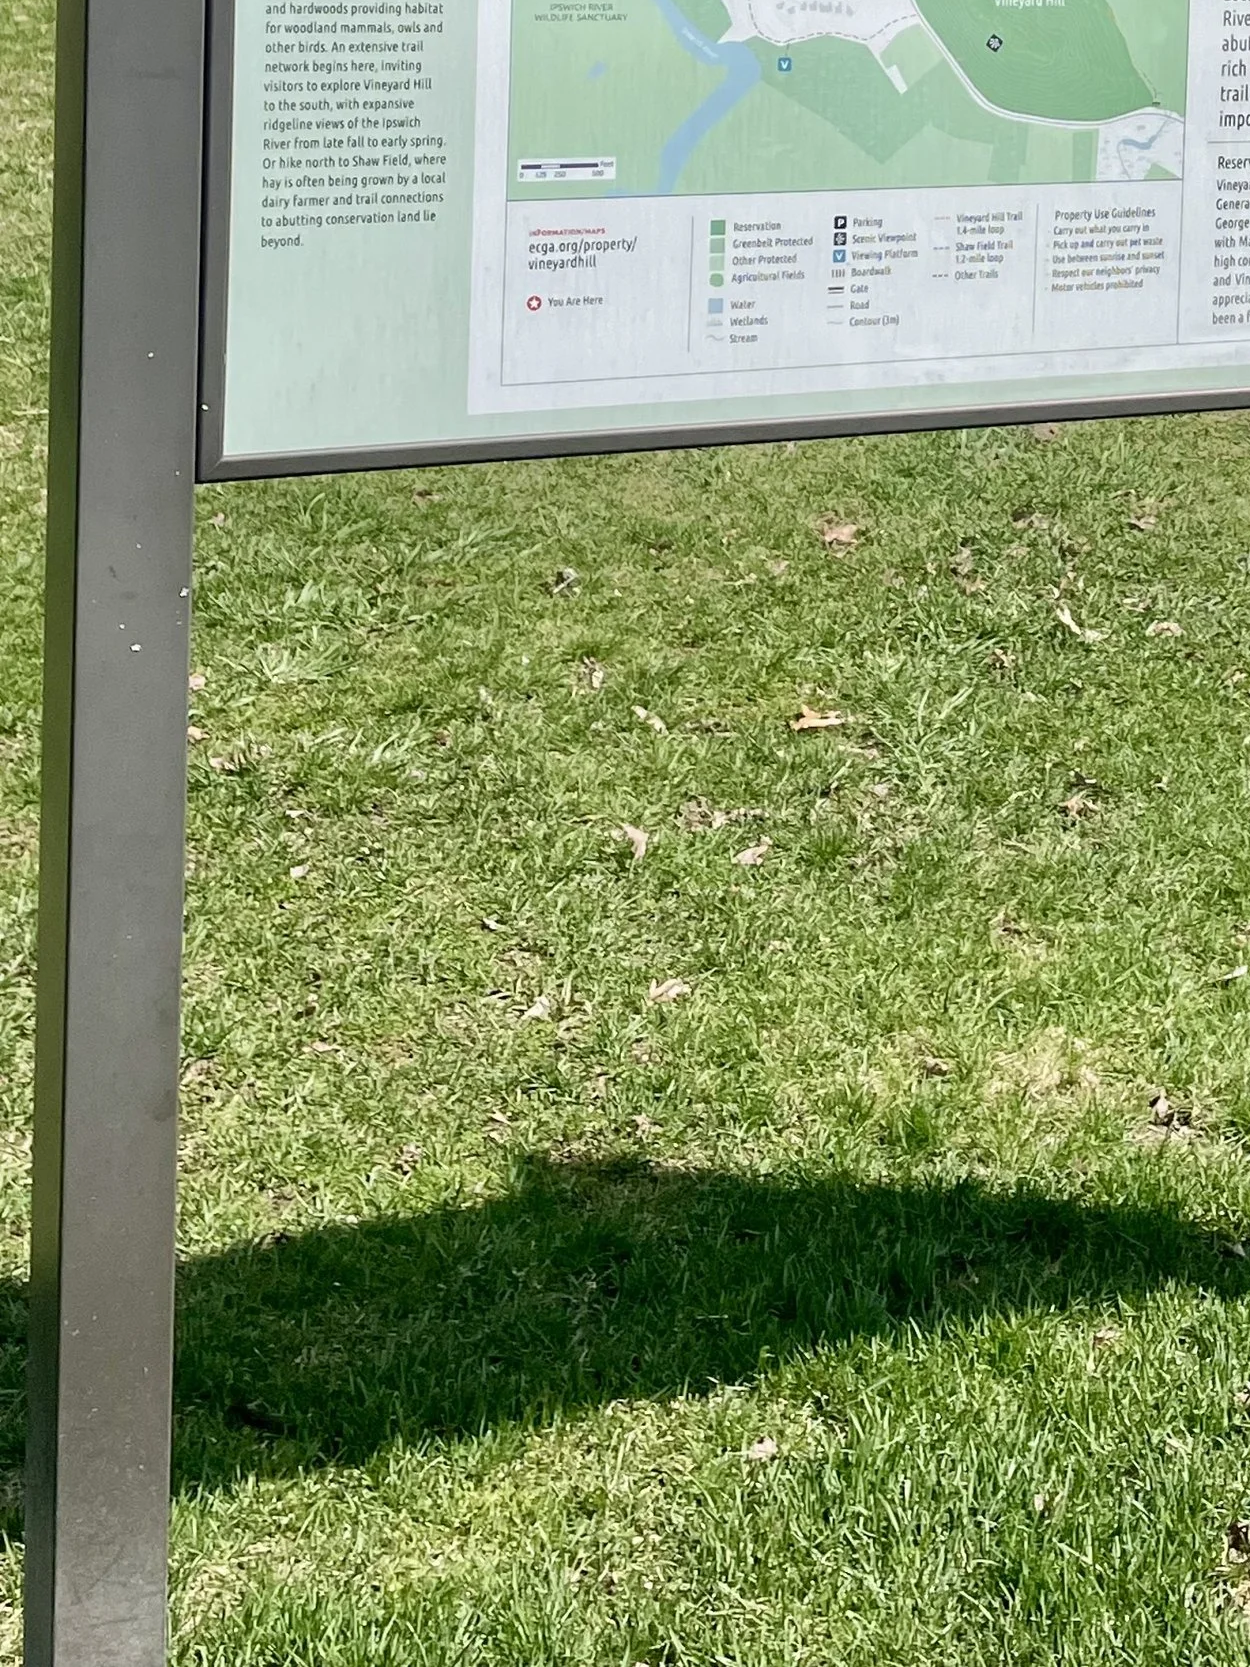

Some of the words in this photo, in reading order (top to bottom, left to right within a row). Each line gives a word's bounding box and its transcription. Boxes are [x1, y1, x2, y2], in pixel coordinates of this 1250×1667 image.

[1221, 58, 1247, 76] rich
[1055, 209, 1093, 222] Property
[1094, 208, 1110, 219] Use
[1111, 206, 1156, 218] Guidelines
[733, 221, 781, 232] Reservation
[529, 236, 637, 256] ecga.org/property/
[733, 237, 773, 249] Greenbelt
[775, 236, 814, 246] Protected
[528, 254, 596, 271] vineyardhill
[732, 255, 757, 265] Other
[758, 253, 797, 264] Protected
[548, 297, 564, 307] You
[565, 296, 581, 306] Are
[583, 295, 603, 305] Here
